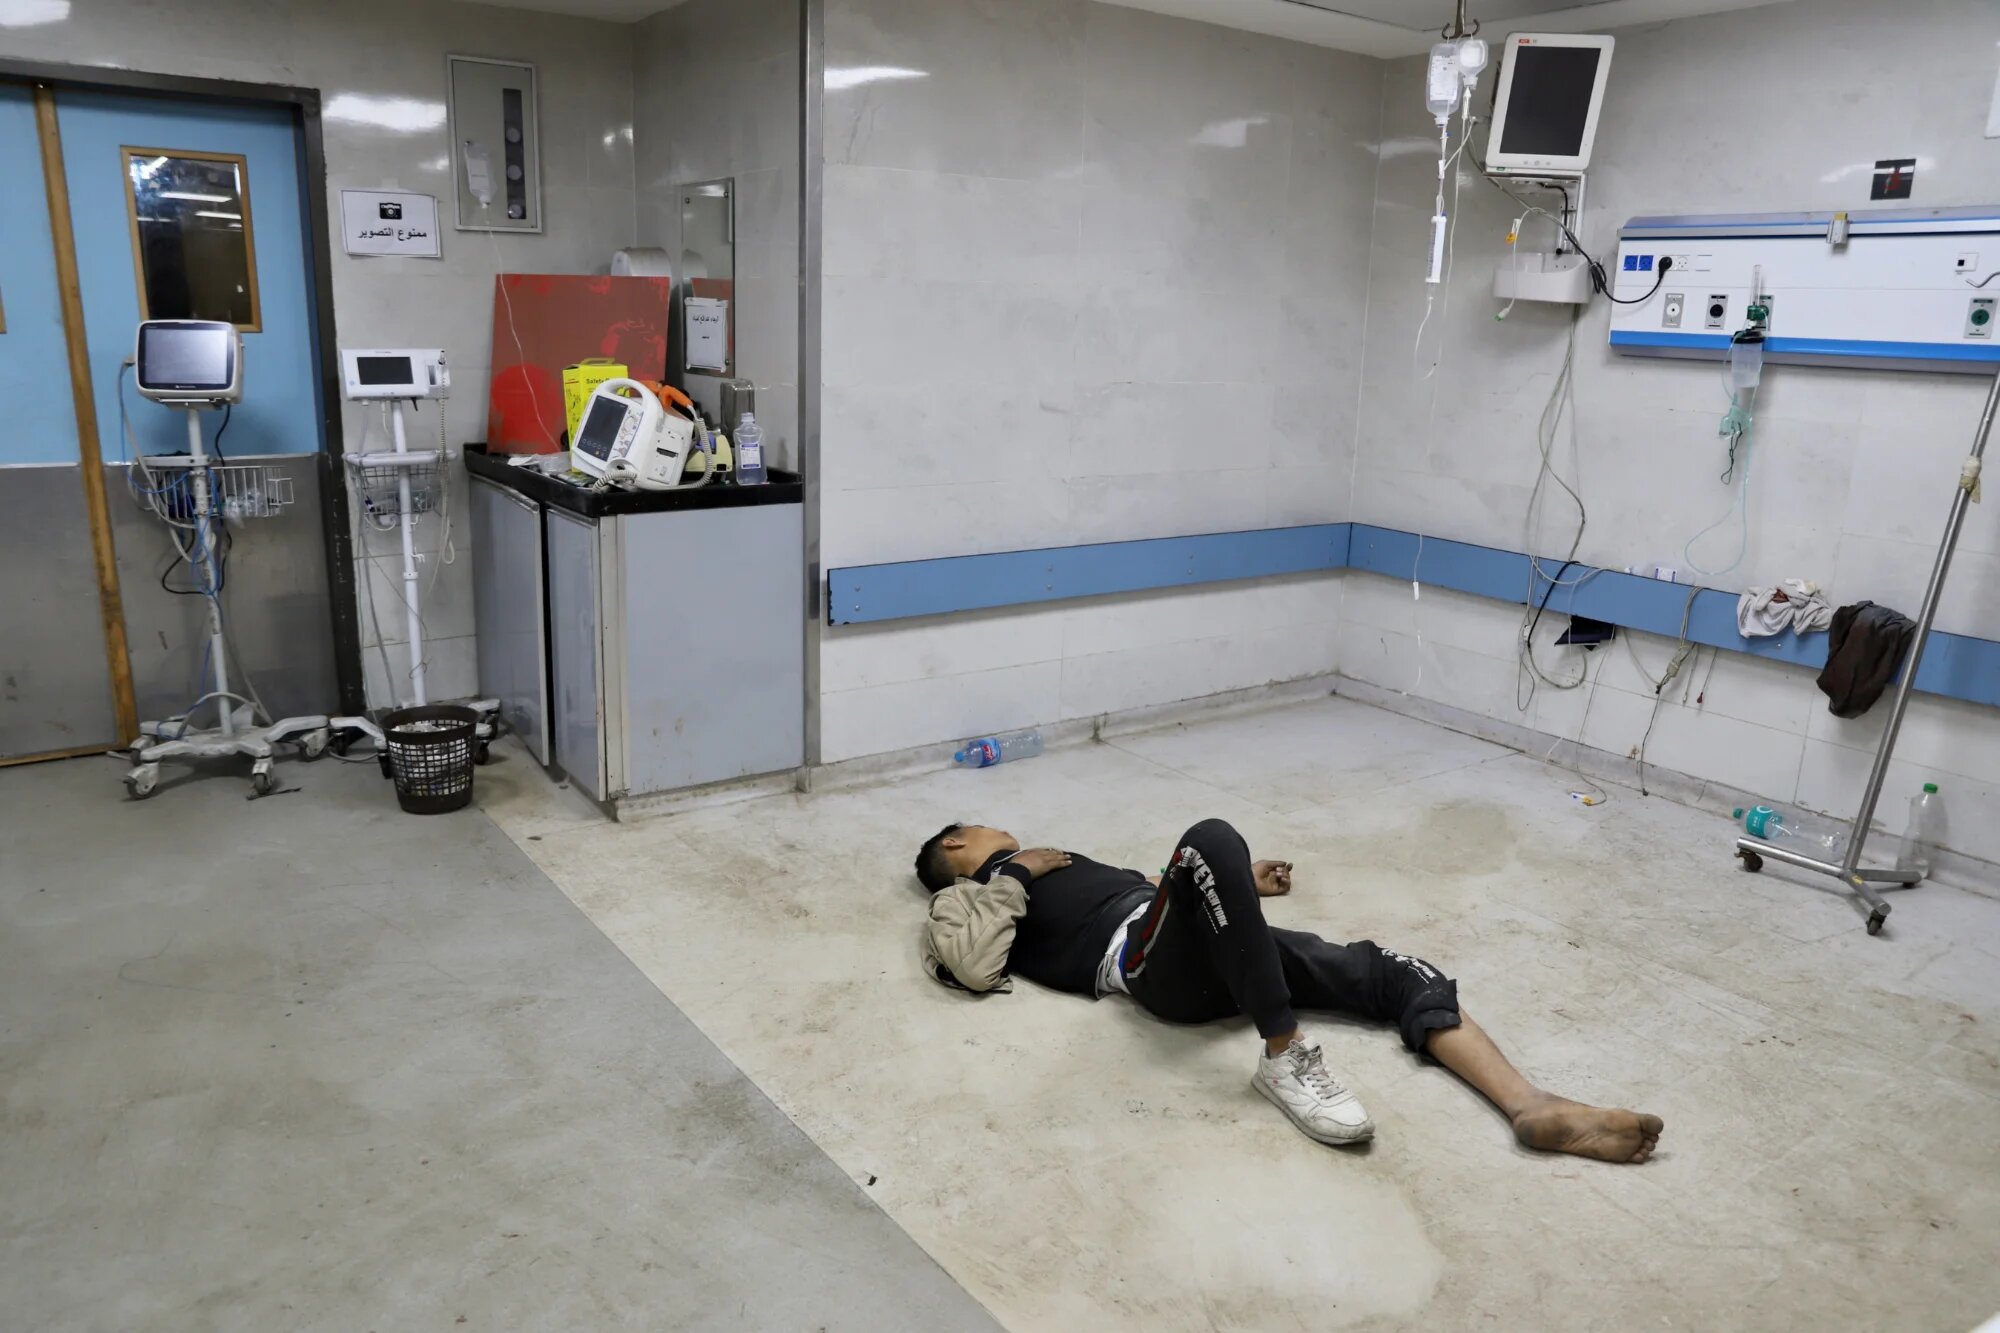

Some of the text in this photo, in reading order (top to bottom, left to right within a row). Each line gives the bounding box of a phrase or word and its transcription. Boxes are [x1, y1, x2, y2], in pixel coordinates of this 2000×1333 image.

[358, 227, 427, 241] ممنوع التصوير
[1213, 904, 1229, 927] YORK
